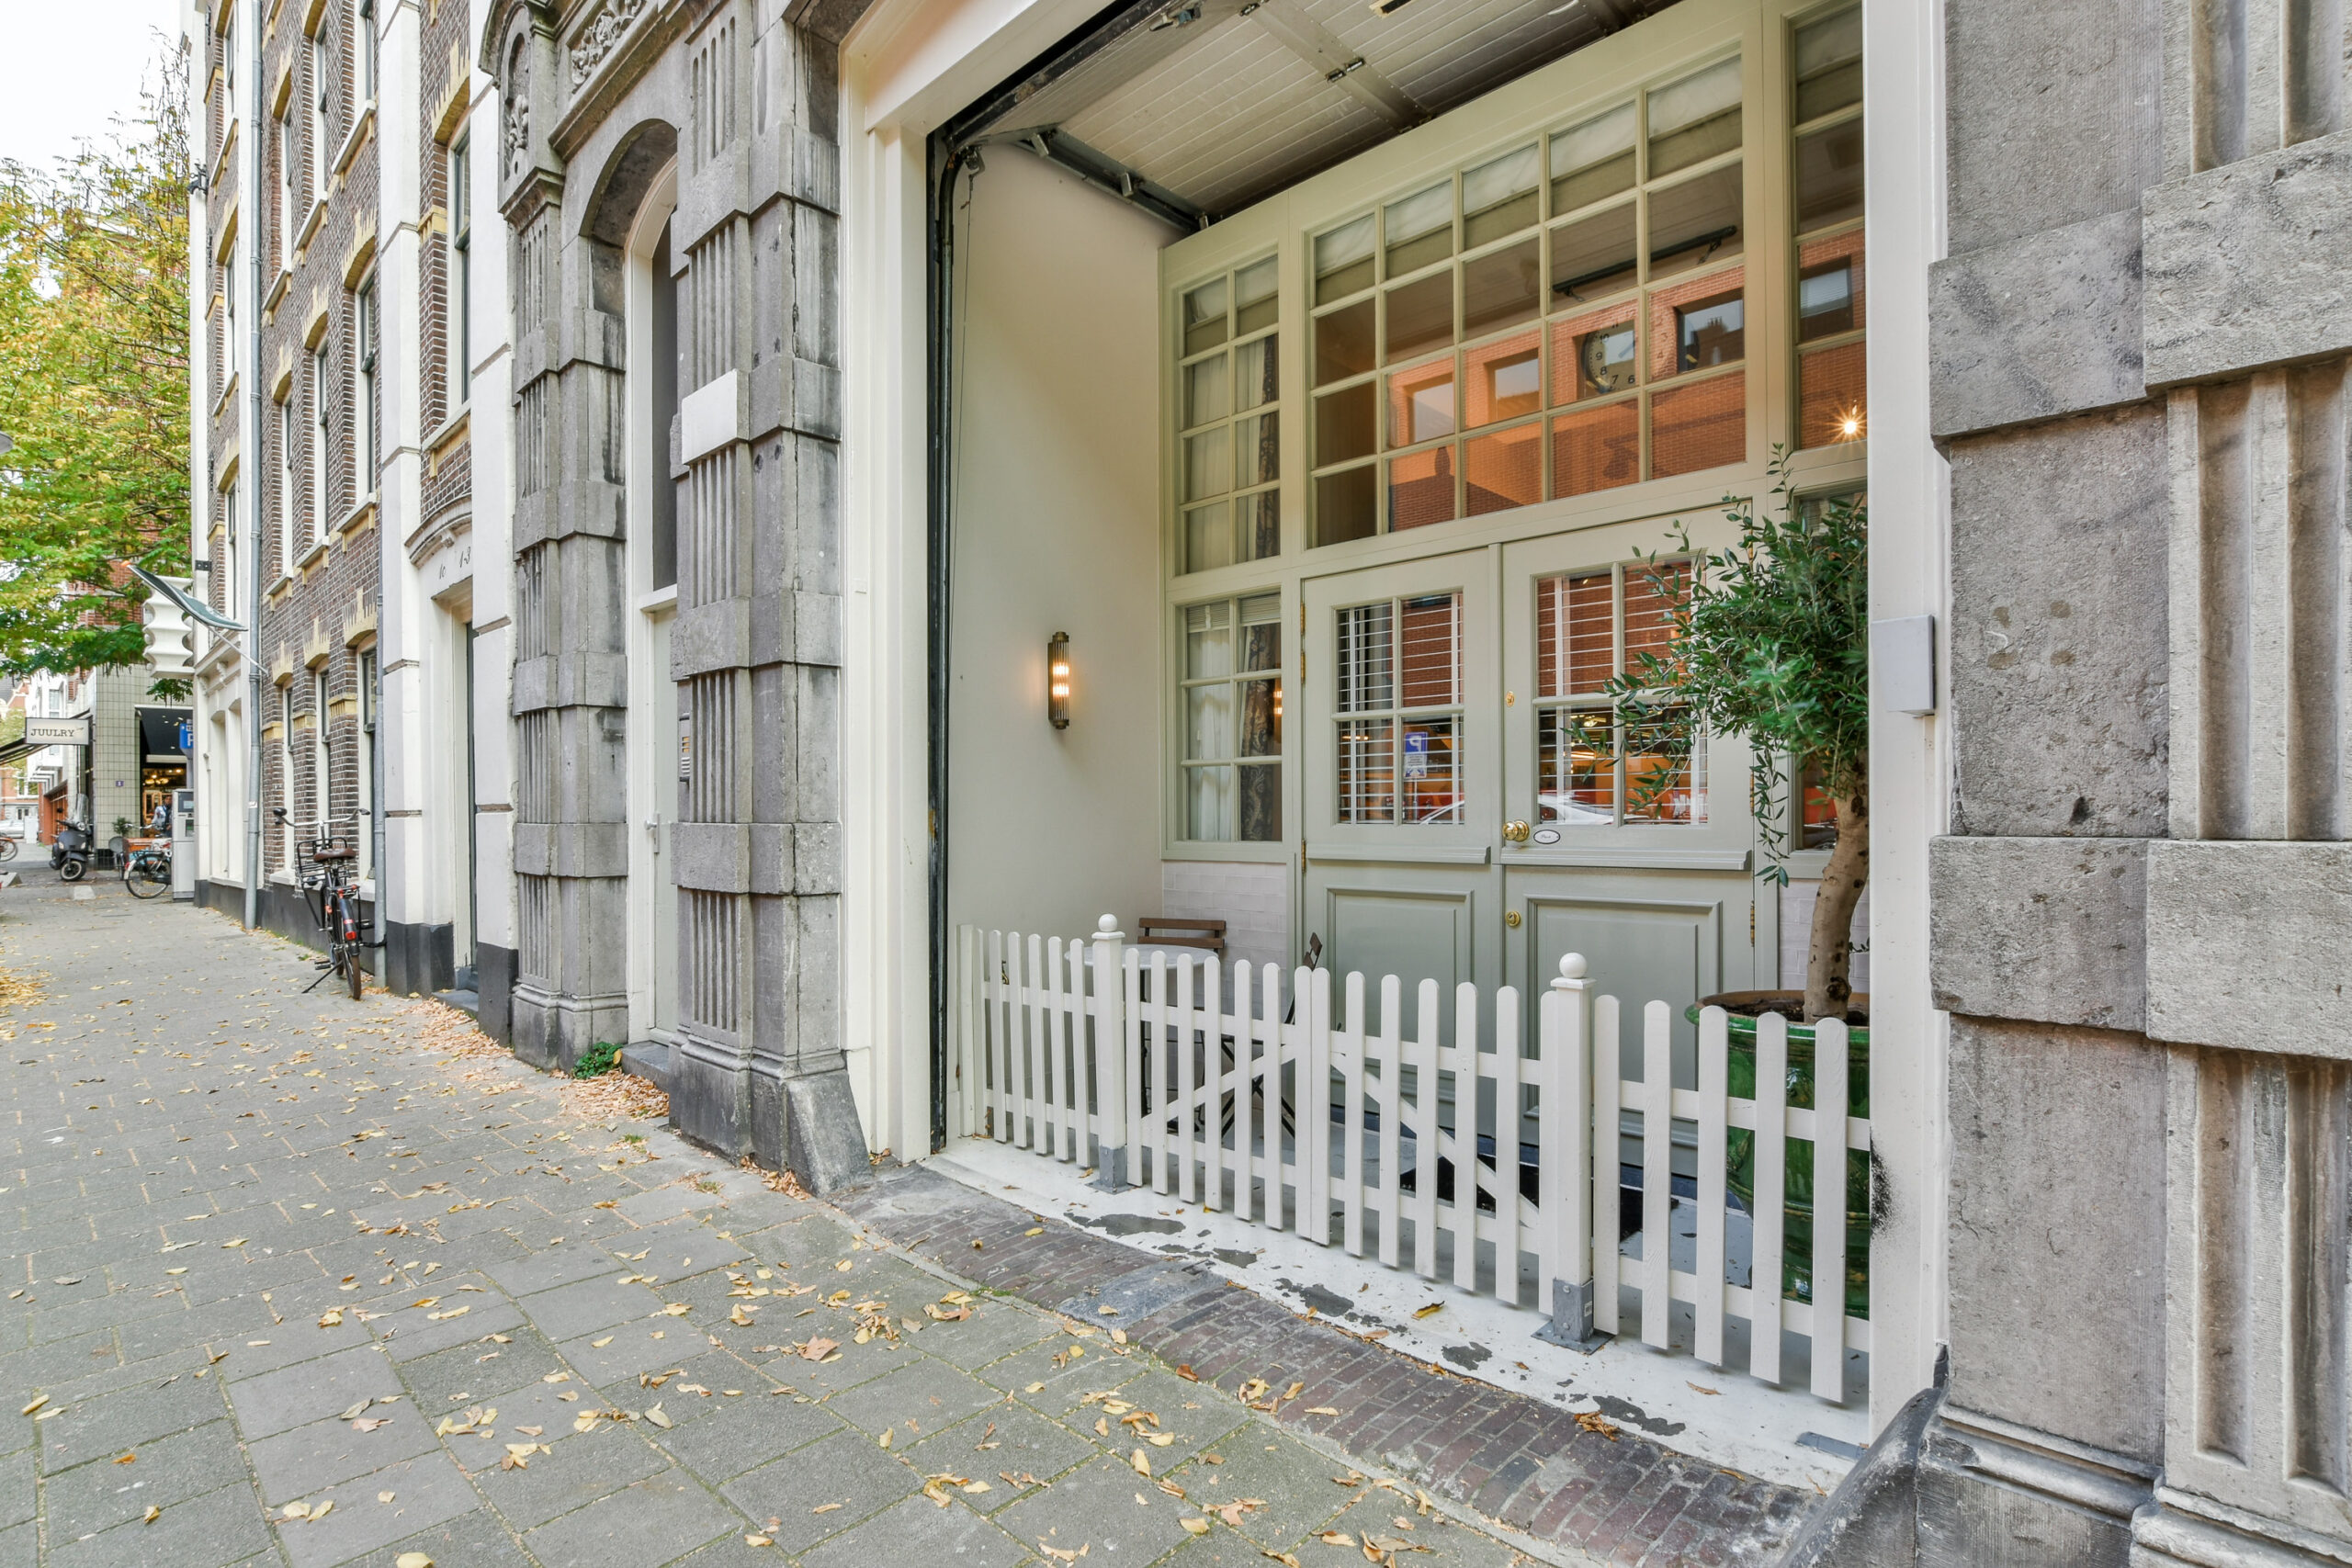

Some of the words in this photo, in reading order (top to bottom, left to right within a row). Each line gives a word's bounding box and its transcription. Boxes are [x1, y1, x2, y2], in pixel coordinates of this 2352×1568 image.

[1595, 352, 1603, 361] 9
[1600, 366, 1608, 376] 8
[1628, 374, 1635, 384] 6
[31, 728, 74, 738] JUULRY
